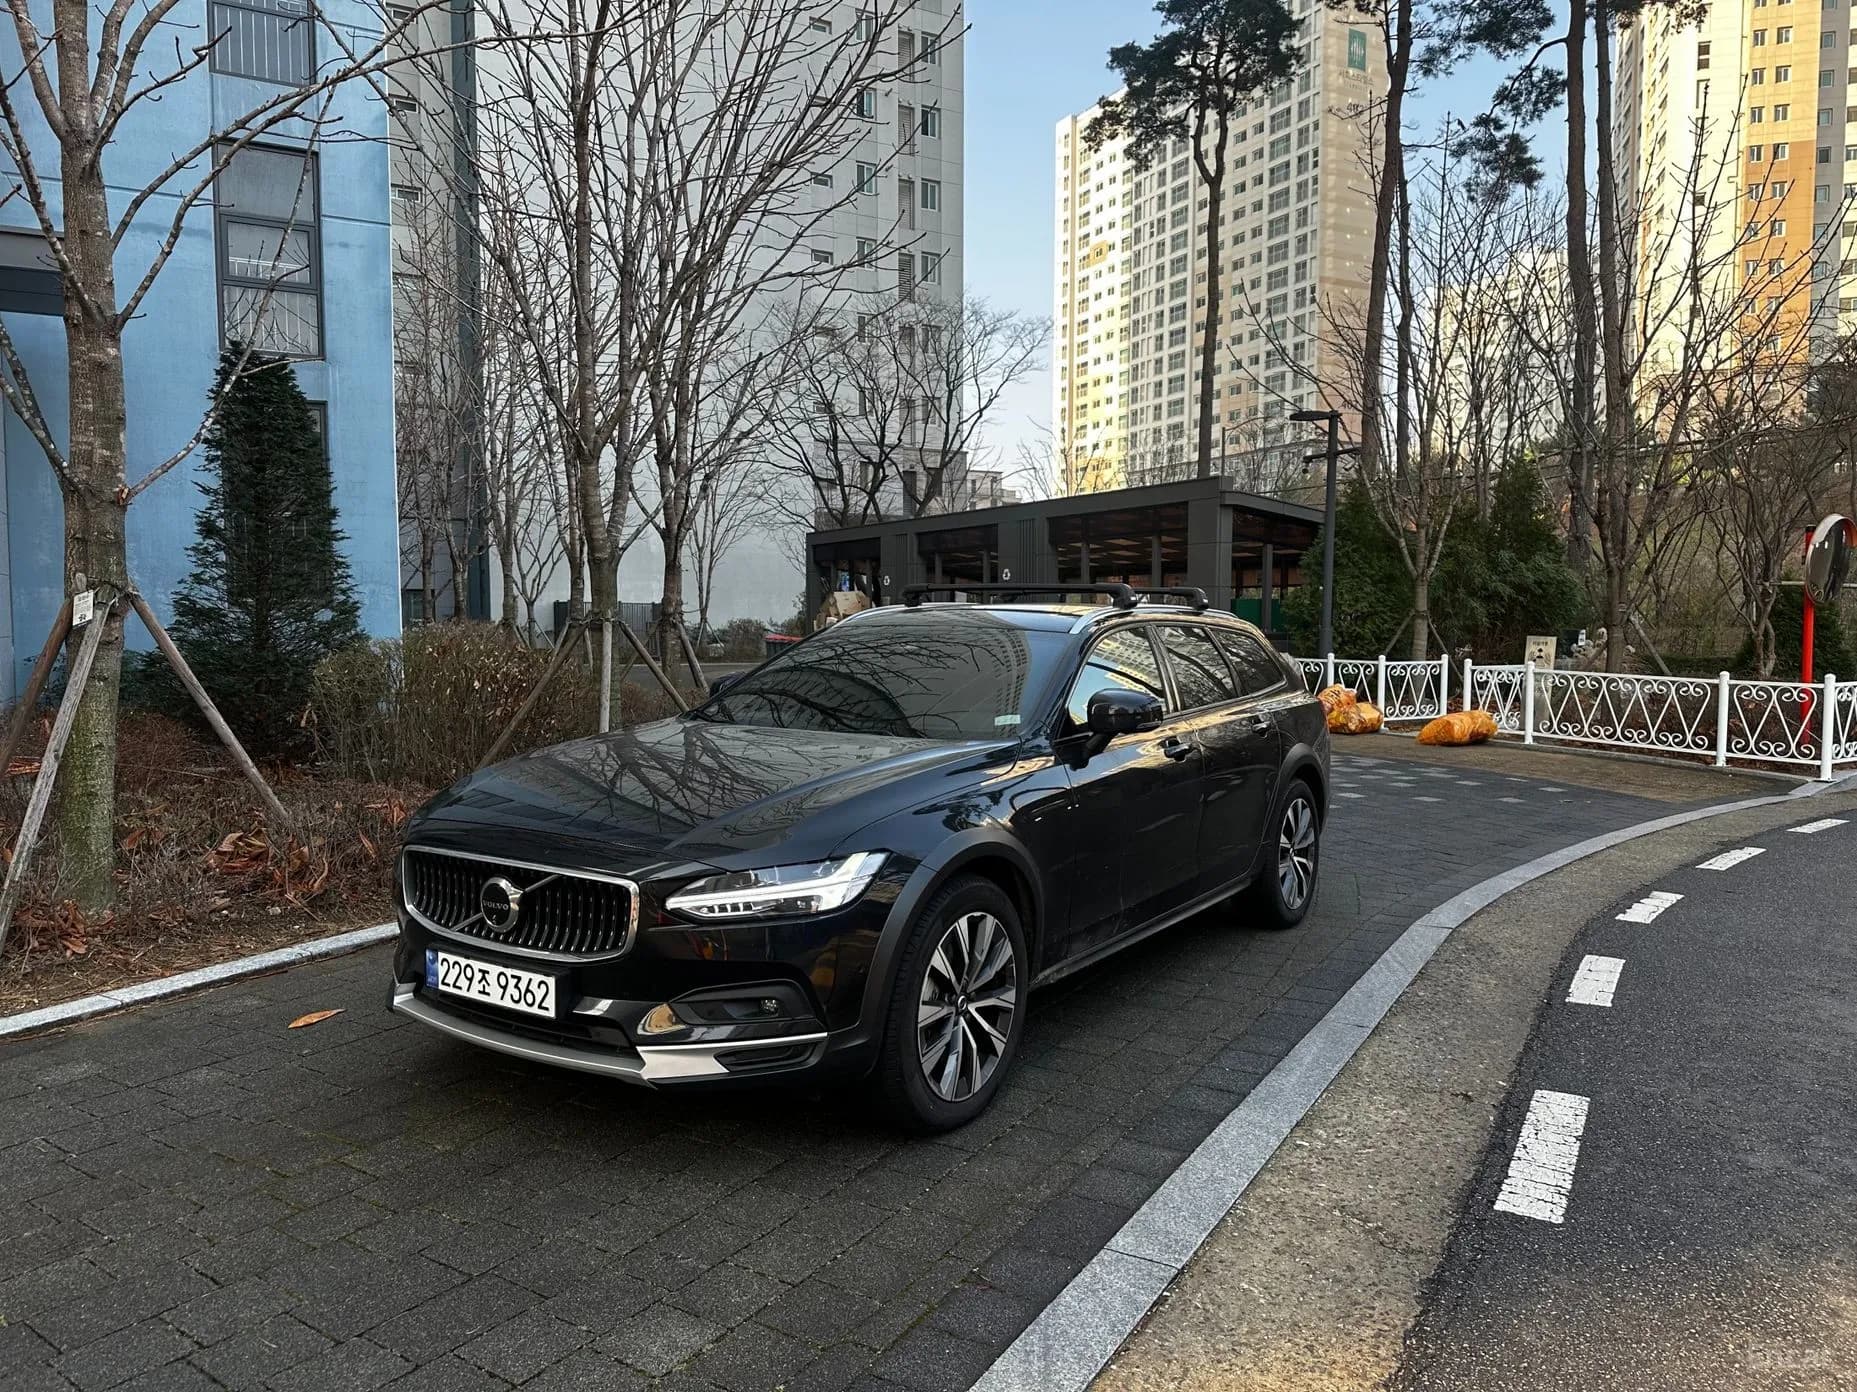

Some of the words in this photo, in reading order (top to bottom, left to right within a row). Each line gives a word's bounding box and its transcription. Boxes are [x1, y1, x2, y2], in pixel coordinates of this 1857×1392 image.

[482, 899, 509, 910] VOLVO
[440, 957, 491, 997] 229조
[497, 971, 550, 1011] 9362
